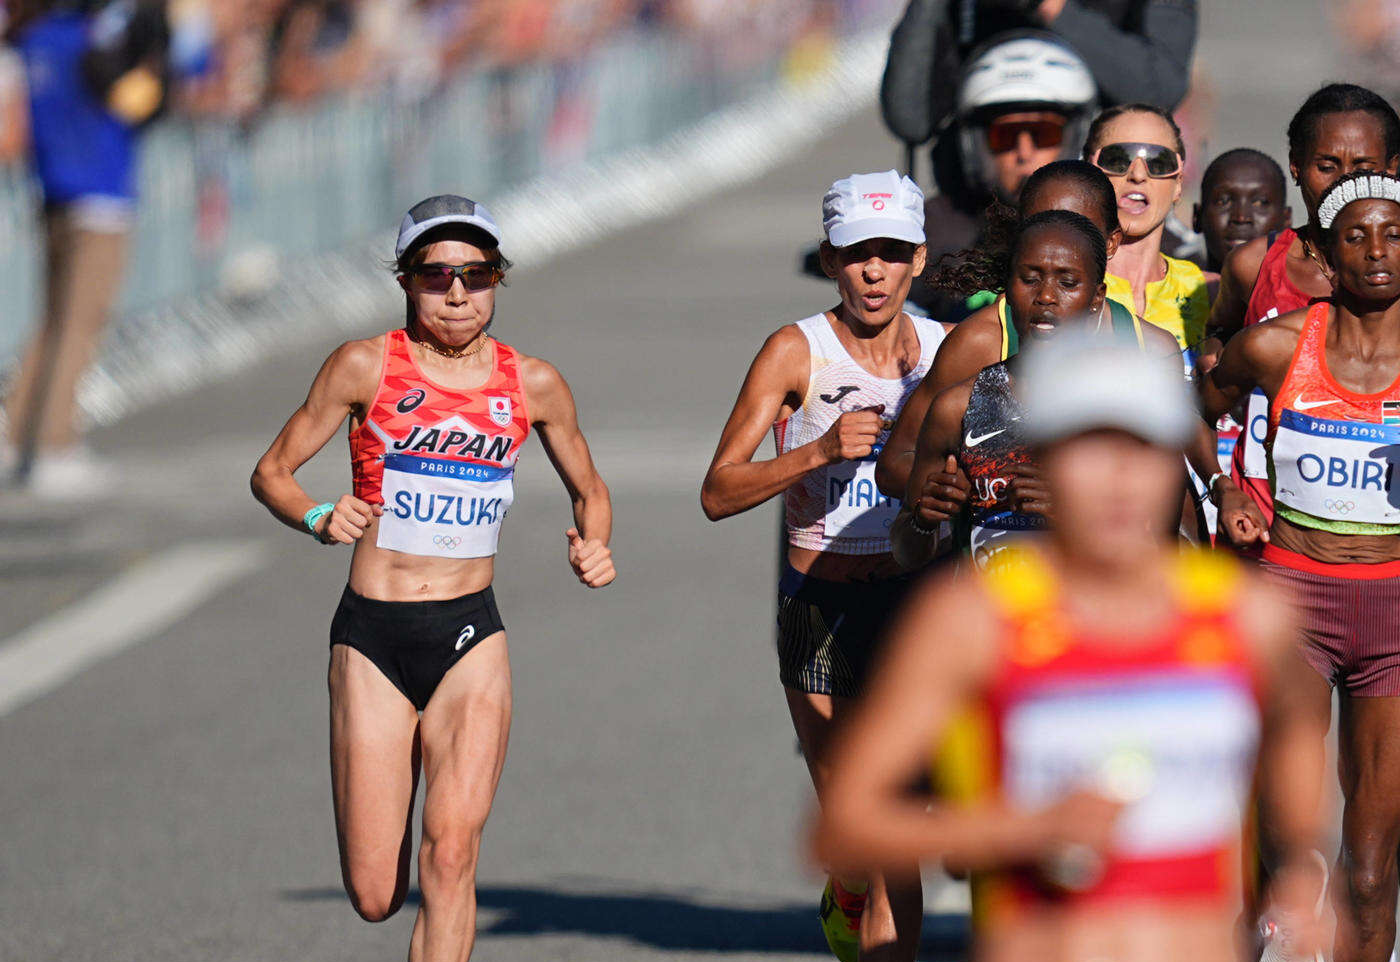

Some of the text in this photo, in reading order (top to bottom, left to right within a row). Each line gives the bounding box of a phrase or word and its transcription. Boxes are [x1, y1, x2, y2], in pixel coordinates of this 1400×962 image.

[393, 426, 513, 463] JAPAN
[1310, 421, 1385, 439] PARIS 2024
[420, 461, 489, 478] PARIS 2024
[1296, 453, 1394, 492] OBIRI
[393, 490, 503, 527] SUZUKI
